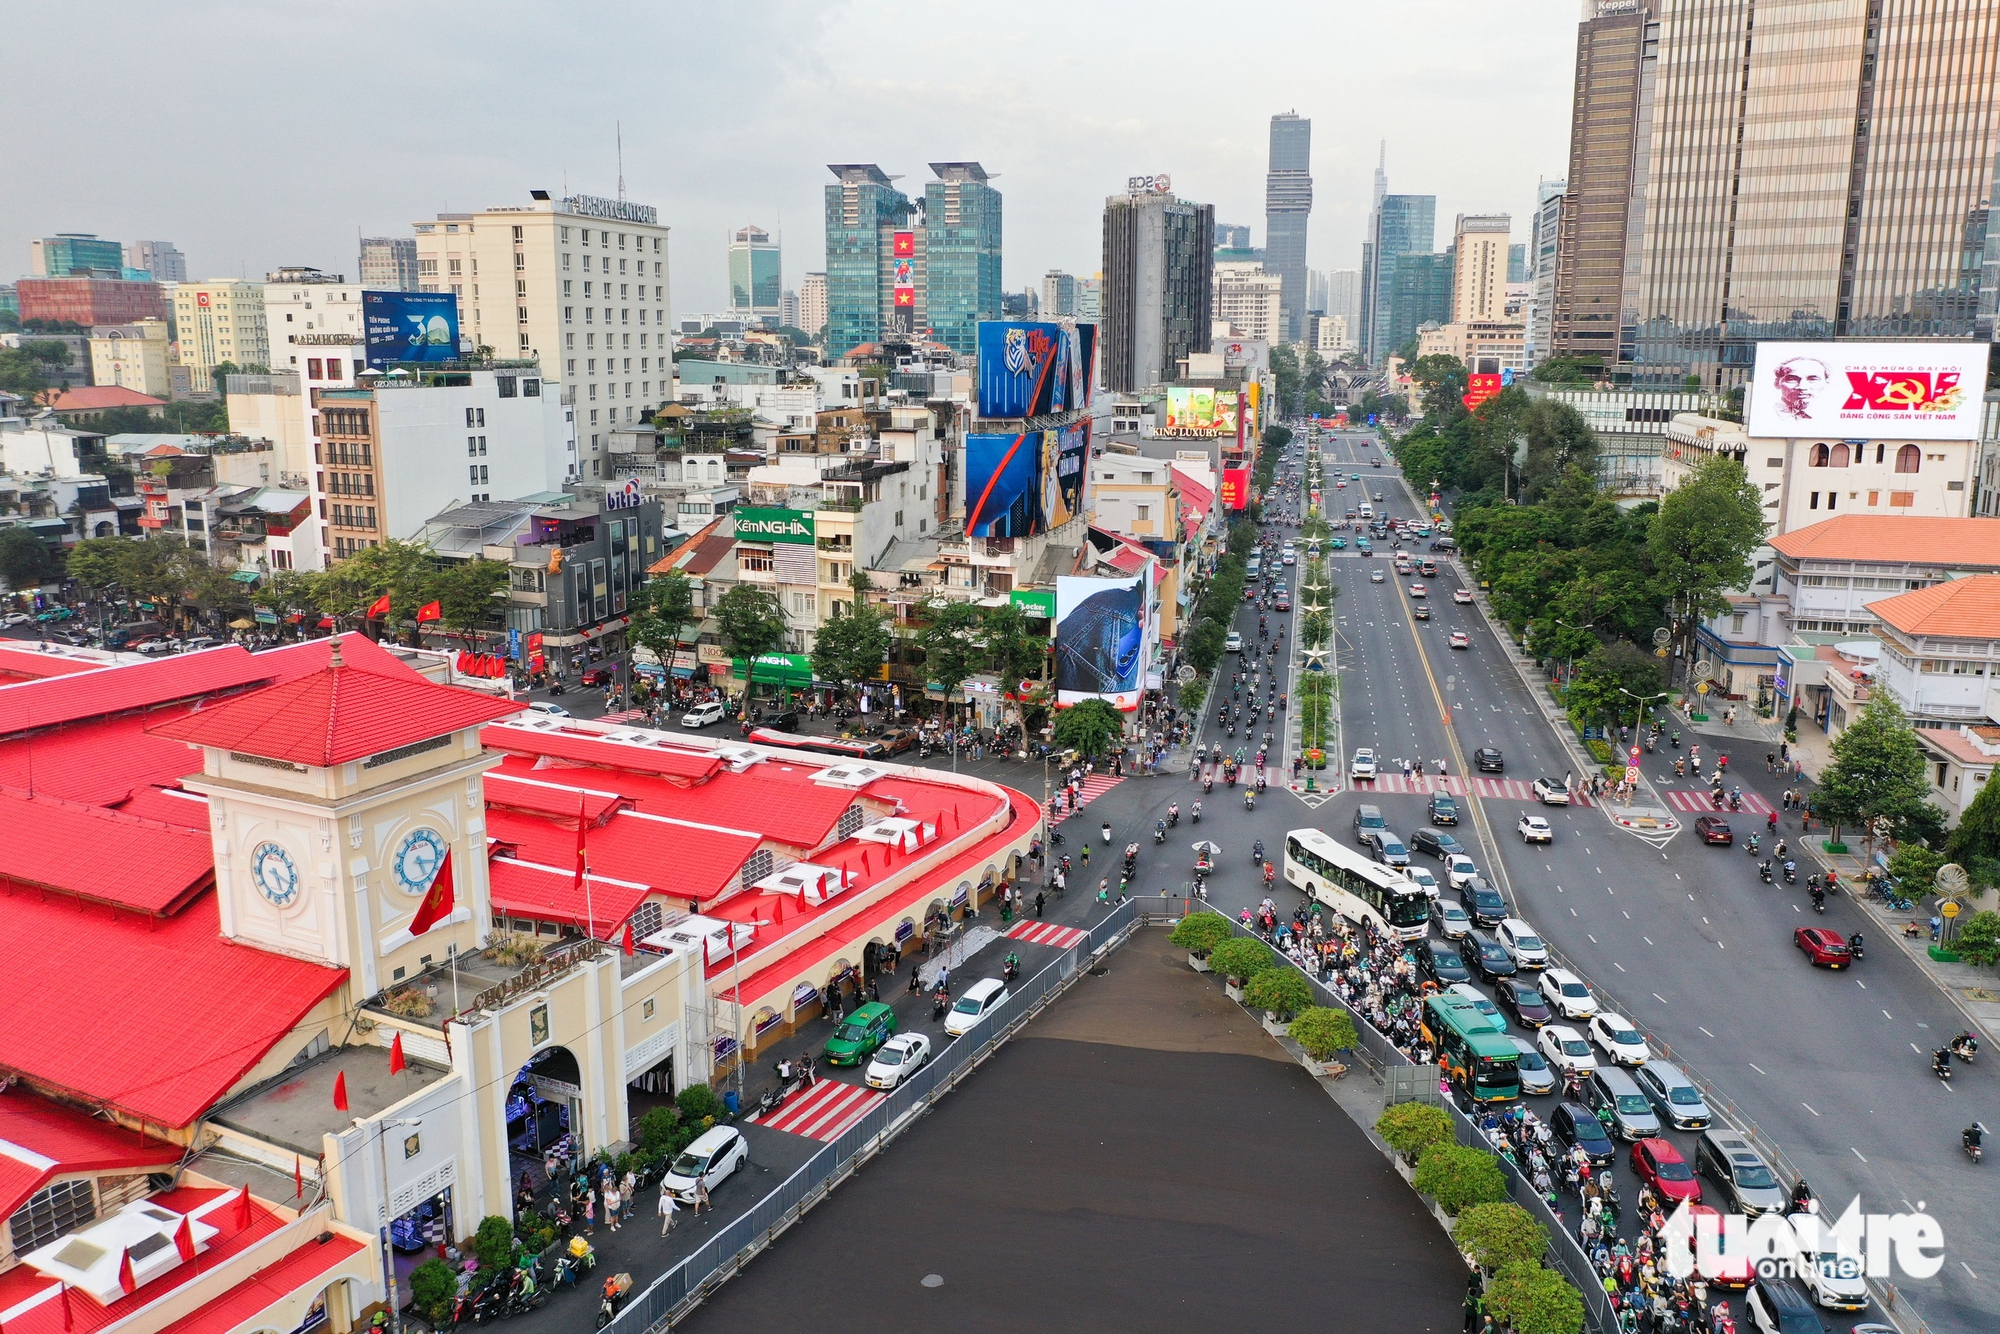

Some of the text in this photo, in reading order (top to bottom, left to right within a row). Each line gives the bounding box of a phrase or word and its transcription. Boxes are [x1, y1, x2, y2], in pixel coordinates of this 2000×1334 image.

[1598, 0, 1635, 9] Keppel
[577, 194, 656, 223] LIBERTY CENTRAL
[1027, 328, 1051, 363] Tiger
[1153, 428, 1177, 437] KING
[1180, 428, 1219, 437] LUXURY
